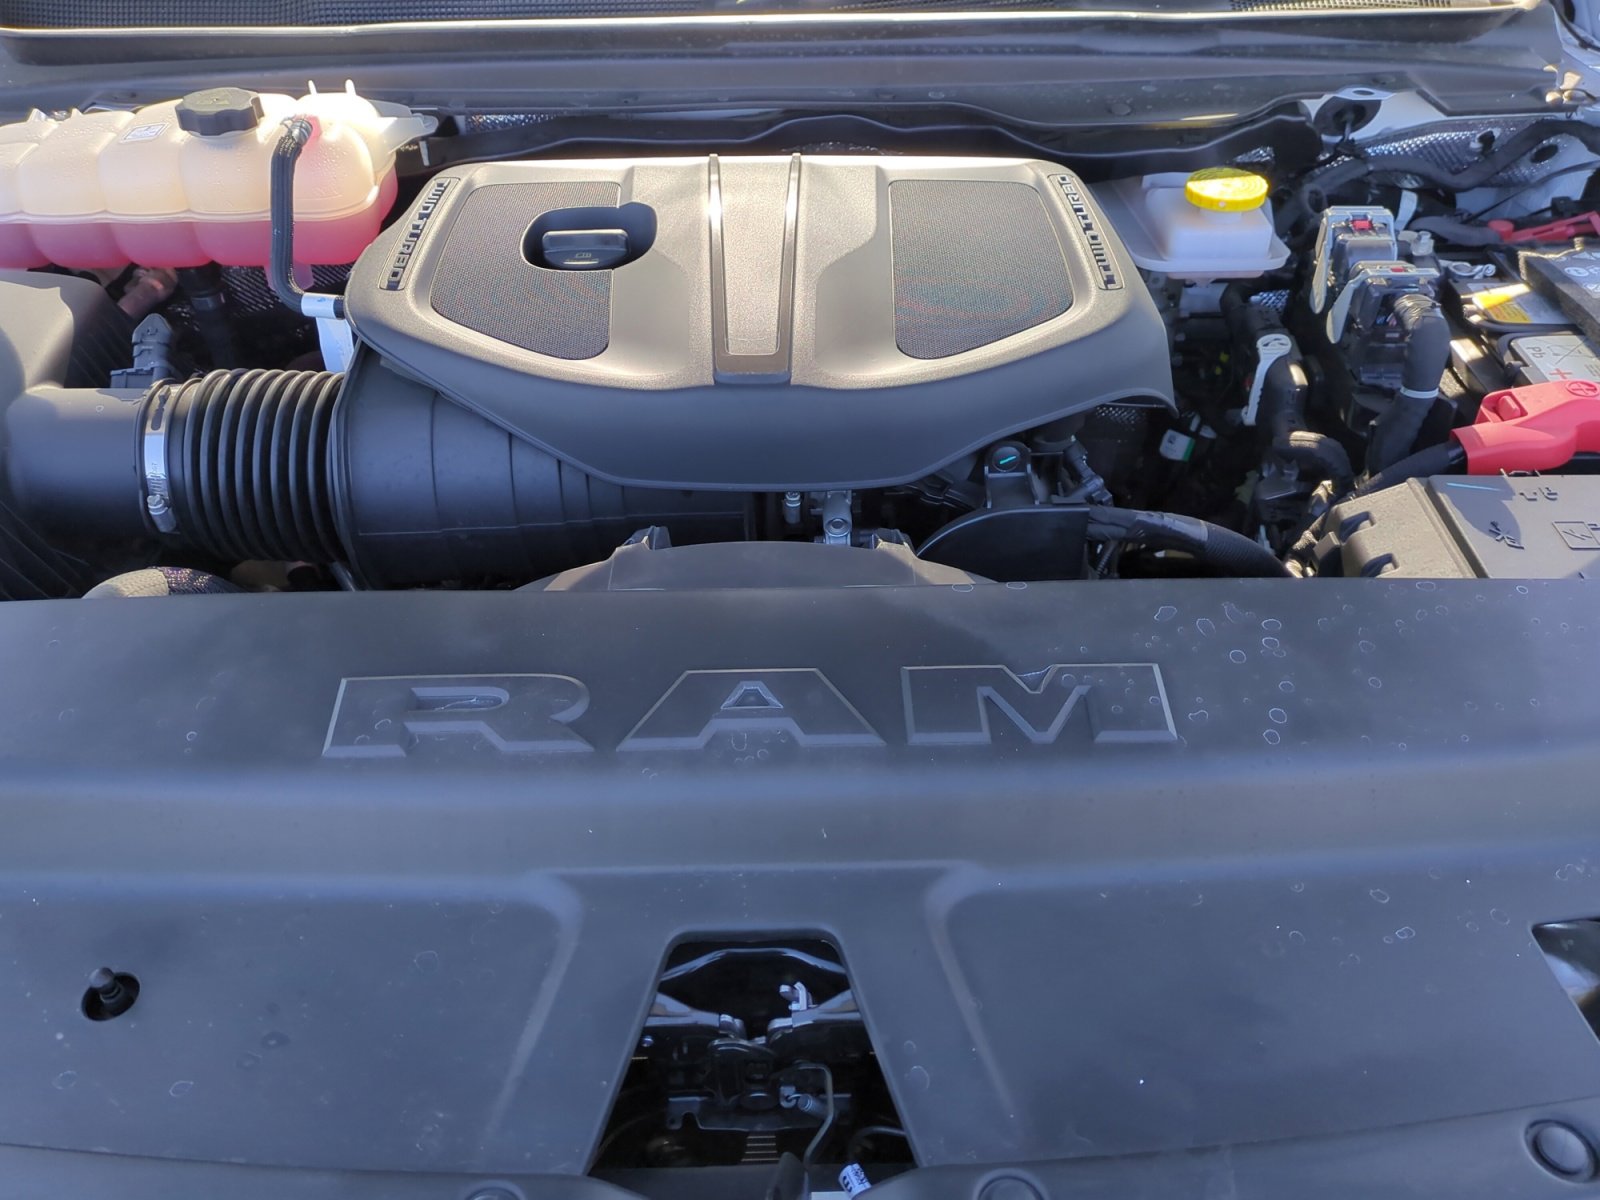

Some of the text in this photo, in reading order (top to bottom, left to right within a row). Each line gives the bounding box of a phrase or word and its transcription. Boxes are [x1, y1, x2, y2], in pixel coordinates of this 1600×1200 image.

[386, 178, 452, 282] TWIN TURBO
[1058, 174, 1112, 278] TWIN TURBO
[321, 662, 1178, 758] RAM
